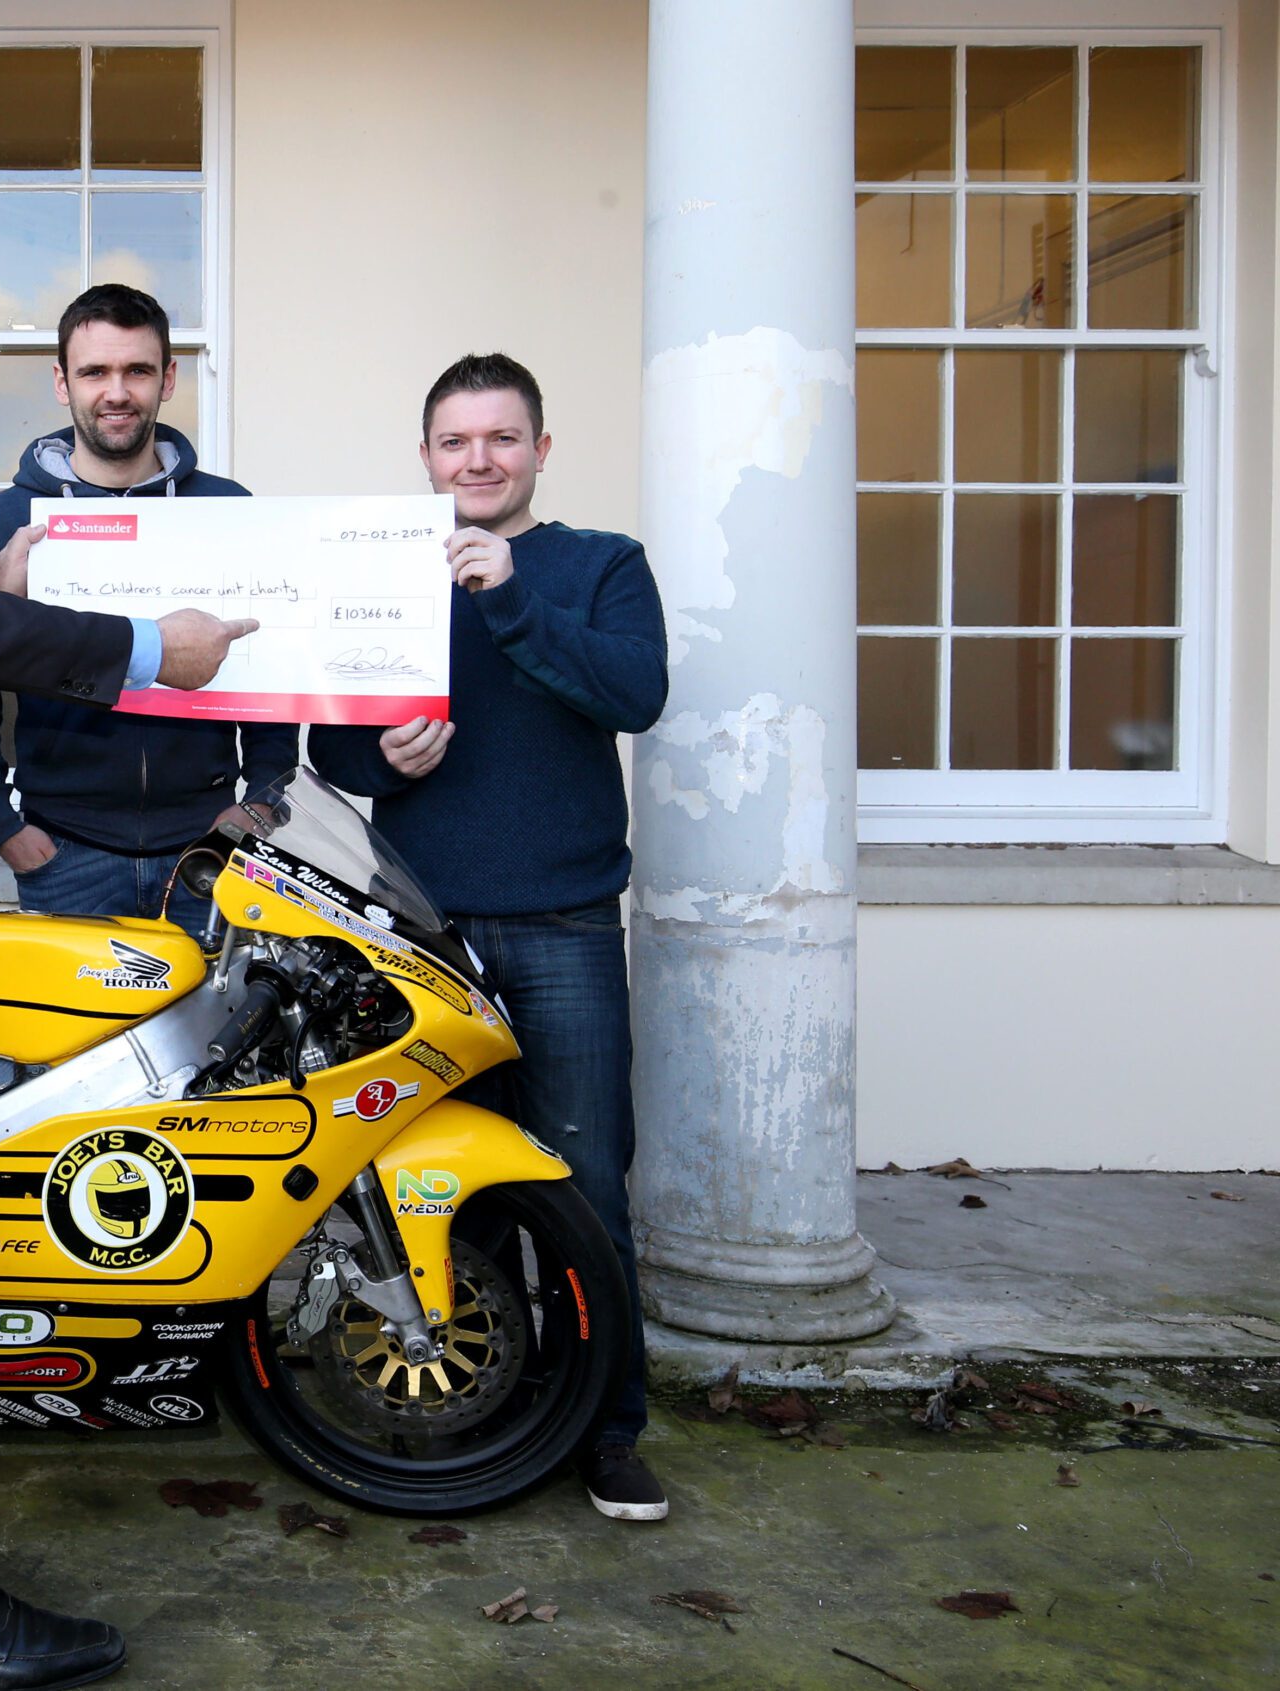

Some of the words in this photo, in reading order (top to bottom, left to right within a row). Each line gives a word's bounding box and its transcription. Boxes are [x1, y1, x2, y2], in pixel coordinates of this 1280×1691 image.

[72, 521, 132, 533] Santander
[68, 582, 92, 596] The
[218, 584, 243, 596] unit
[250, 579, 299, 602] charity
[253, 841, 292, 874] Sam
[297, 865, 349, 905] Wilson
[245, 860, 305, 908] PC
[78, 965, 109, 979] Joey's
[112, 968, 132, 979] Bar
[366, 944, 437, 984] RUSSELL
[104, 978, 169, 989] HONDA
[52, 1132, 126, 1195] JOEY'S
[143, 1140, 185, 1197] BAR
[397, 1169, 460, 1201] ND
[398, 1203, 454, 1214] MEDIA
[89, 1247, 150, 1266] M.C.C.
[152, 1322, 224, 1331] COOKSTOWN
[157, 1332, 214, 1340] CARAVANS
[103, 1405, 152, 1428] BUTCHERS
[157, 1401, 190, 1418] HEL
